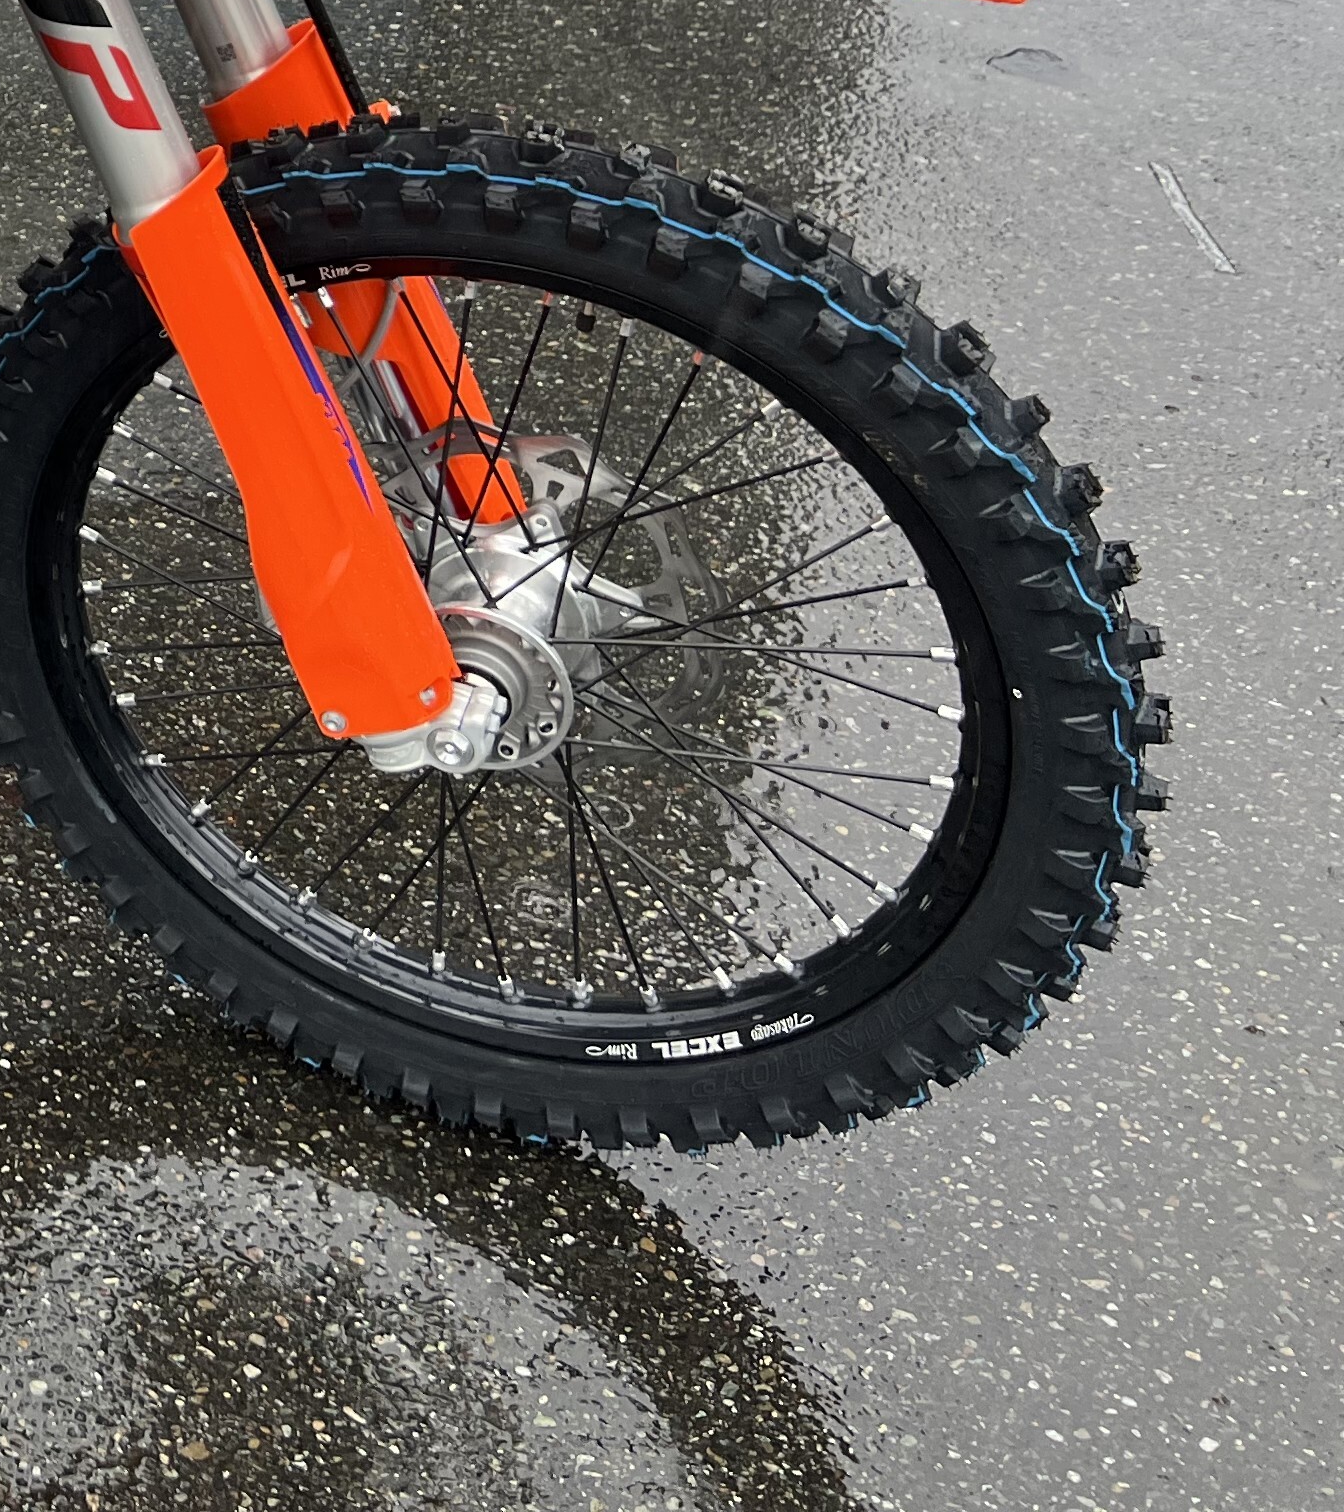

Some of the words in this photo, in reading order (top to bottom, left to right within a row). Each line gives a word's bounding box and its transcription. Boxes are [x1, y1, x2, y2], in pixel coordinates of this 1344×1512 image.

[318, 264, 372, 281] Rim
[750, 1011, 815, 1042] Takasago
[585, 1042, 639, 1061] Rim
[651, 1030, 744, 1059] EXCEL
